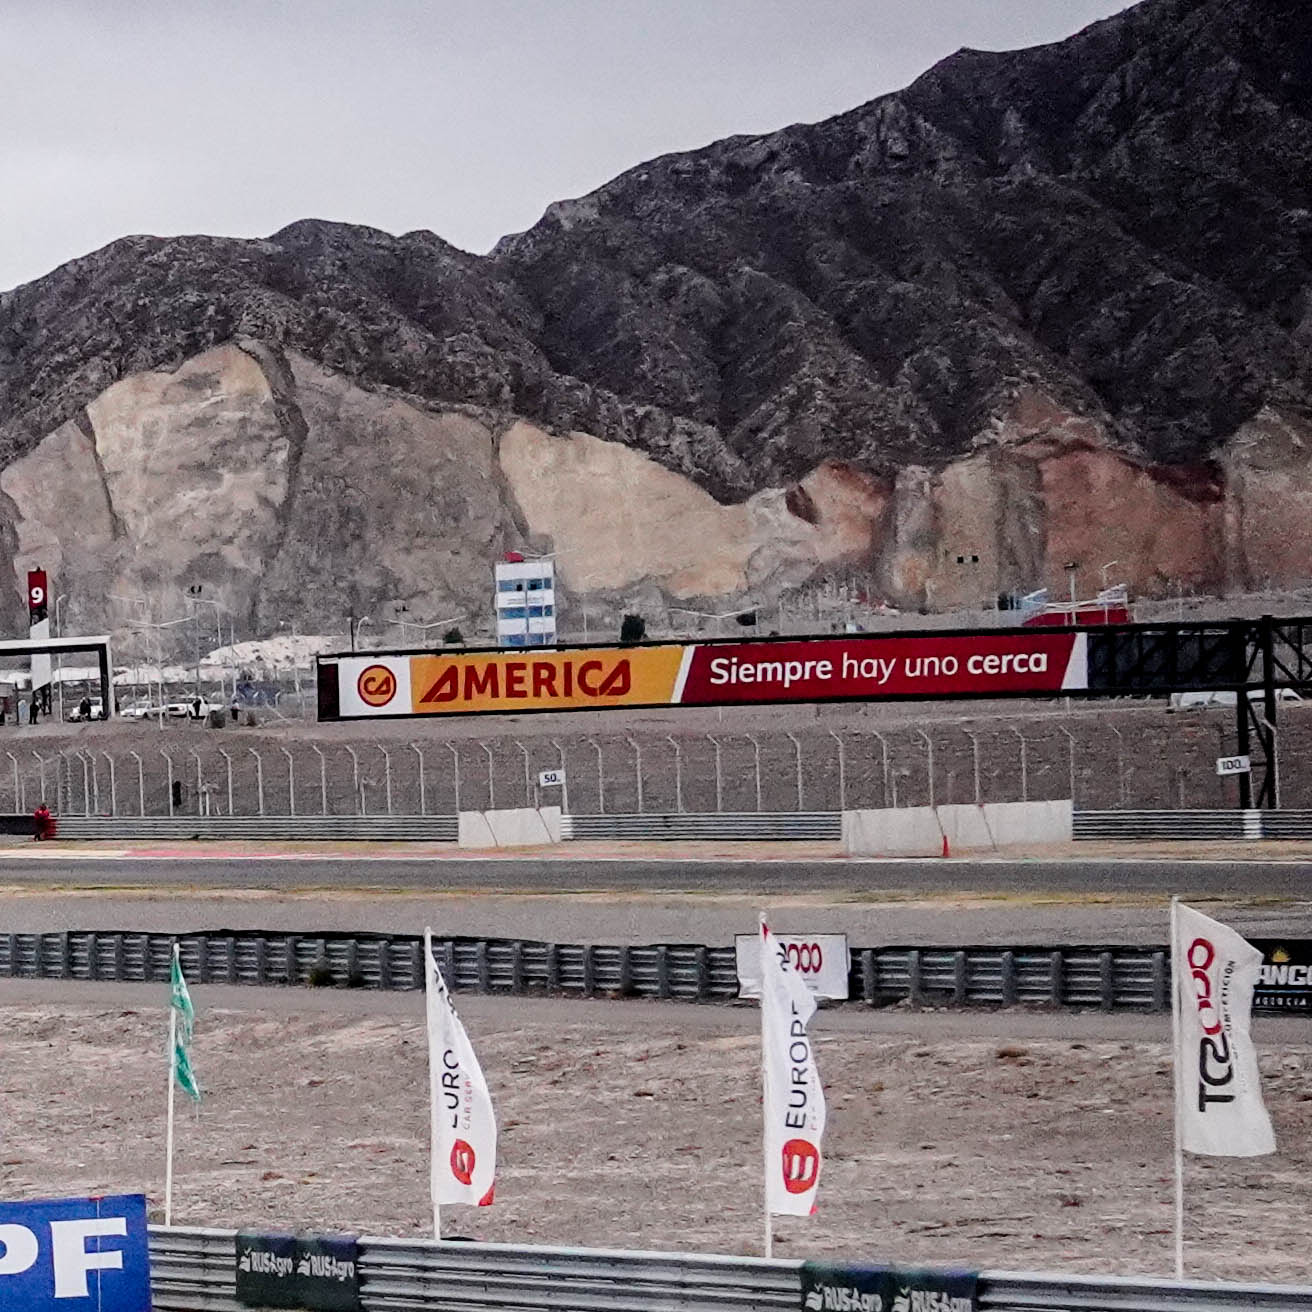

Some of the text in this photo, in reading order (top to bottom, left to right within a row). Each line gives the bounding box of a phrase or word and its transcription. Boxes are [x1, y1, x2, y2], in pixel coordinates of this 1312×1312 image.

[31, 587, 44, 604] 9
[419, 658, 632, 704] AMERICA
[710, 651, 1049, 689] Siempre hay uno cerca
